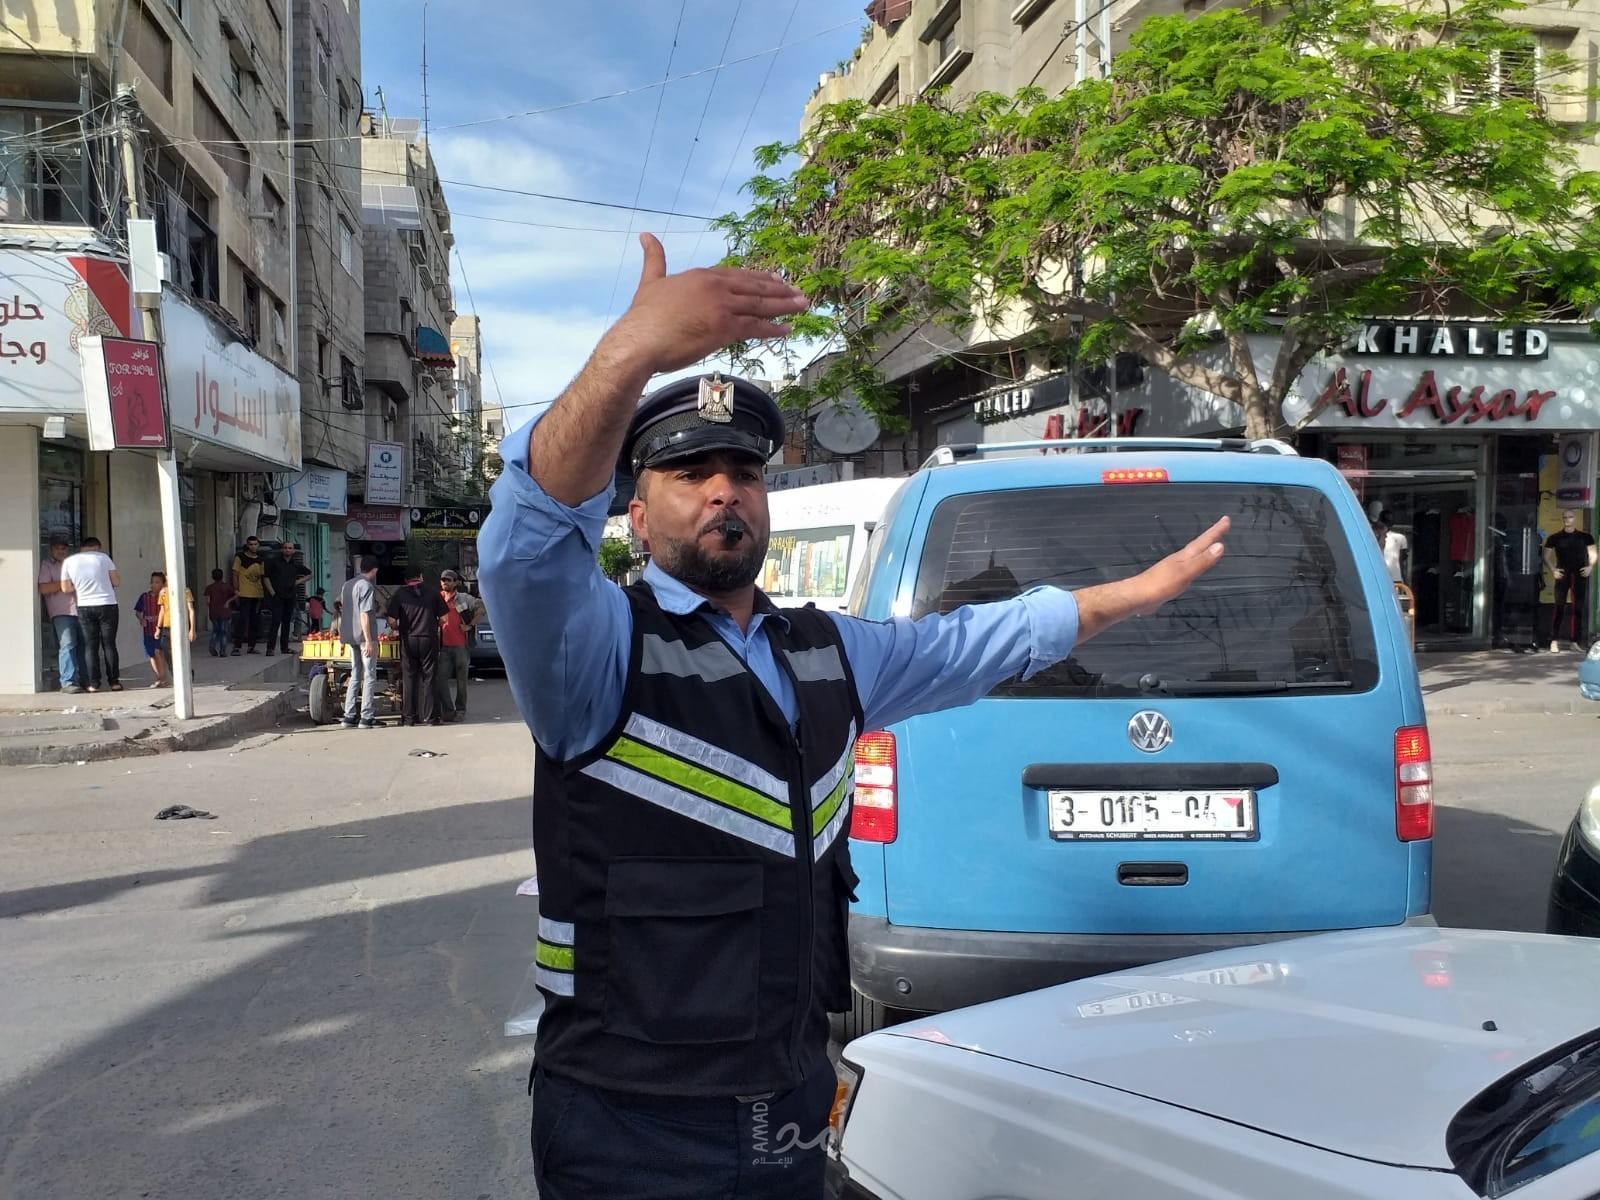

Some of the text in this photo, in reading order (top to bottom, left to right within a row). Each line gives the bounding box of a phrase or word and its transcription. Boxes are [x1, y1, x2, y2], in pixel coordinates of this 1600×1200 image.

[1357, 325, 1548, 356] KHALED
[194, 354, 268, 440] السنوار
[1316, 366, 1557, 425] Al Assar
[1106, 831, 1137, 839] SCHUBERT
